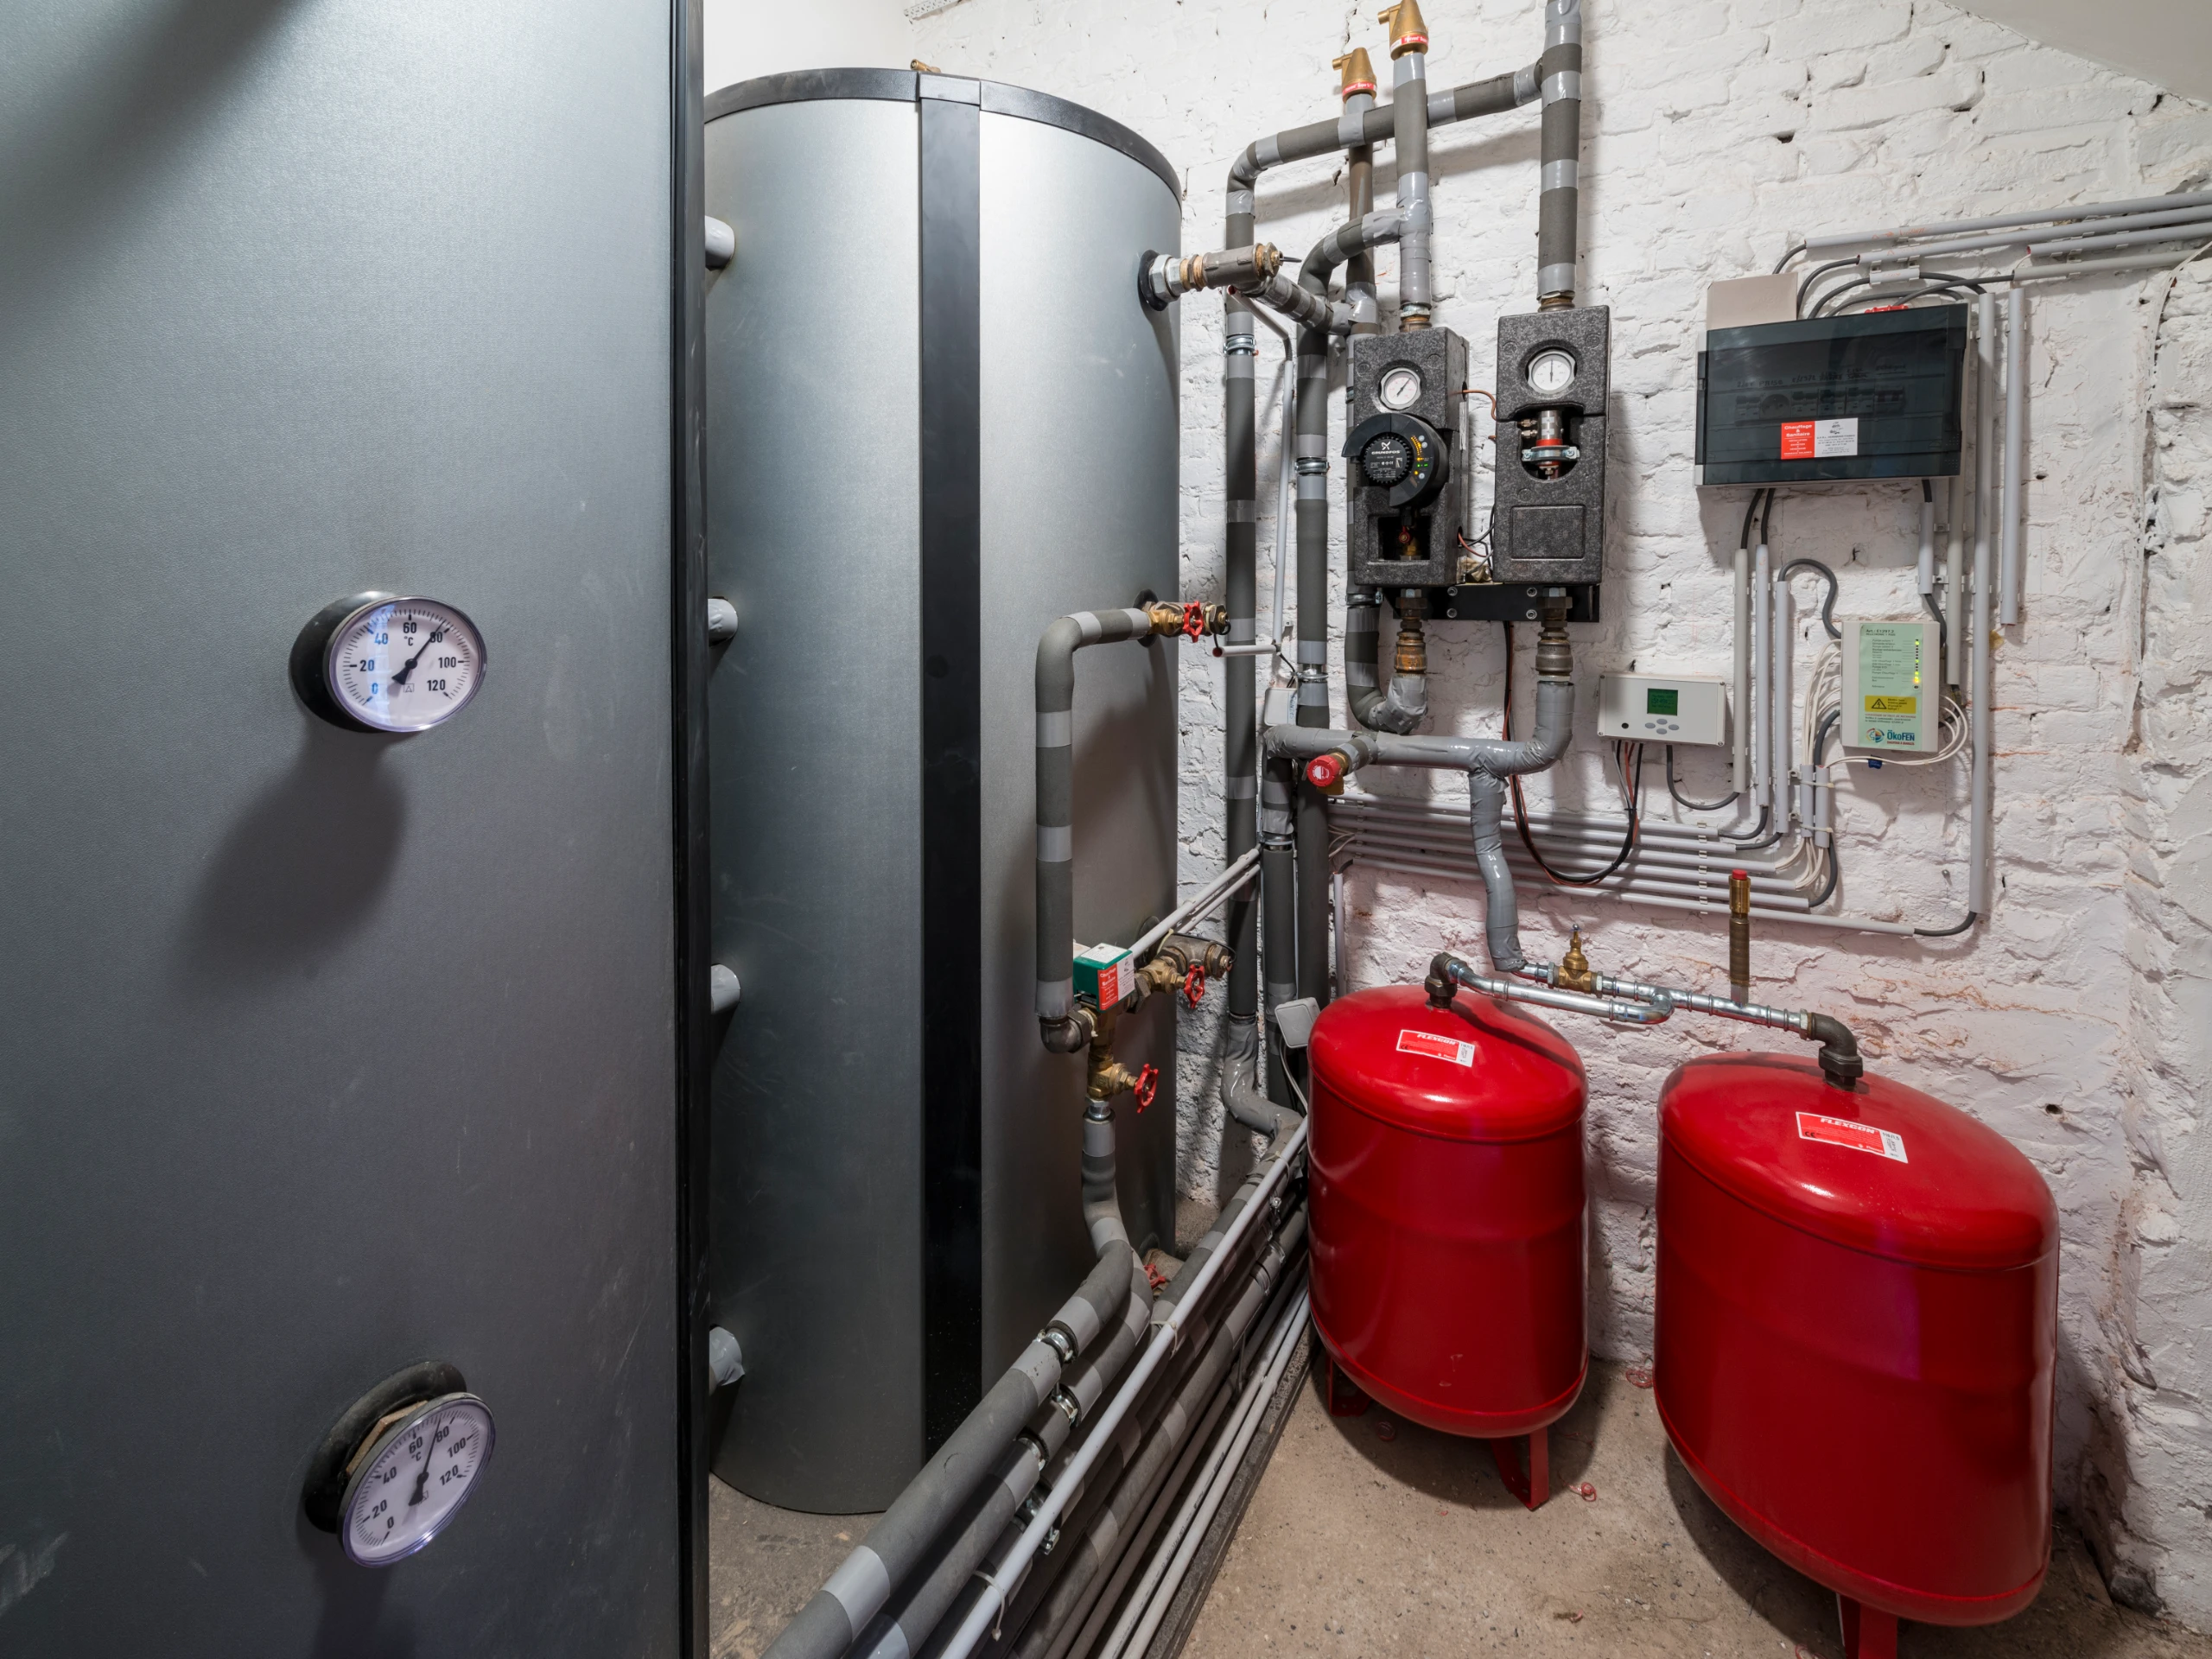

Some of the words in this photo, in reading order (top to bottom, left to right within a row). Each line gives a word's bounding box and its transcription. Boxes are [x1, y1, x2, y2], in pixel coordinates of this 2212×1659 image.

[403, 622, 417, 634] 60
[374, 632, 389, 645] 40
[429, 631, 443, 644] 80
[359, 659, 375, 672] 20
[438, 657, 457, 669] 100
[372, 683, 378, 695] 0
[427, 679, 446, 691] 120
[1887, 729, 1915, 741] ÖkoFEN
[1417, 1033, 1456, 1046] FLEXCON
[1821, 1117, 1875, 1134] FLEXCON
[435, 1426, 449, 1444] 80
[409, 1436, 423, 1455] 60
[448, 1438, 467, 1459] 100
[383, 1465, 397, 1484] 40
[439, 1465, 459, 1486] 120
[372, 1499, 388, 1519] 20
[386, 1516, 395, 1529] 0
